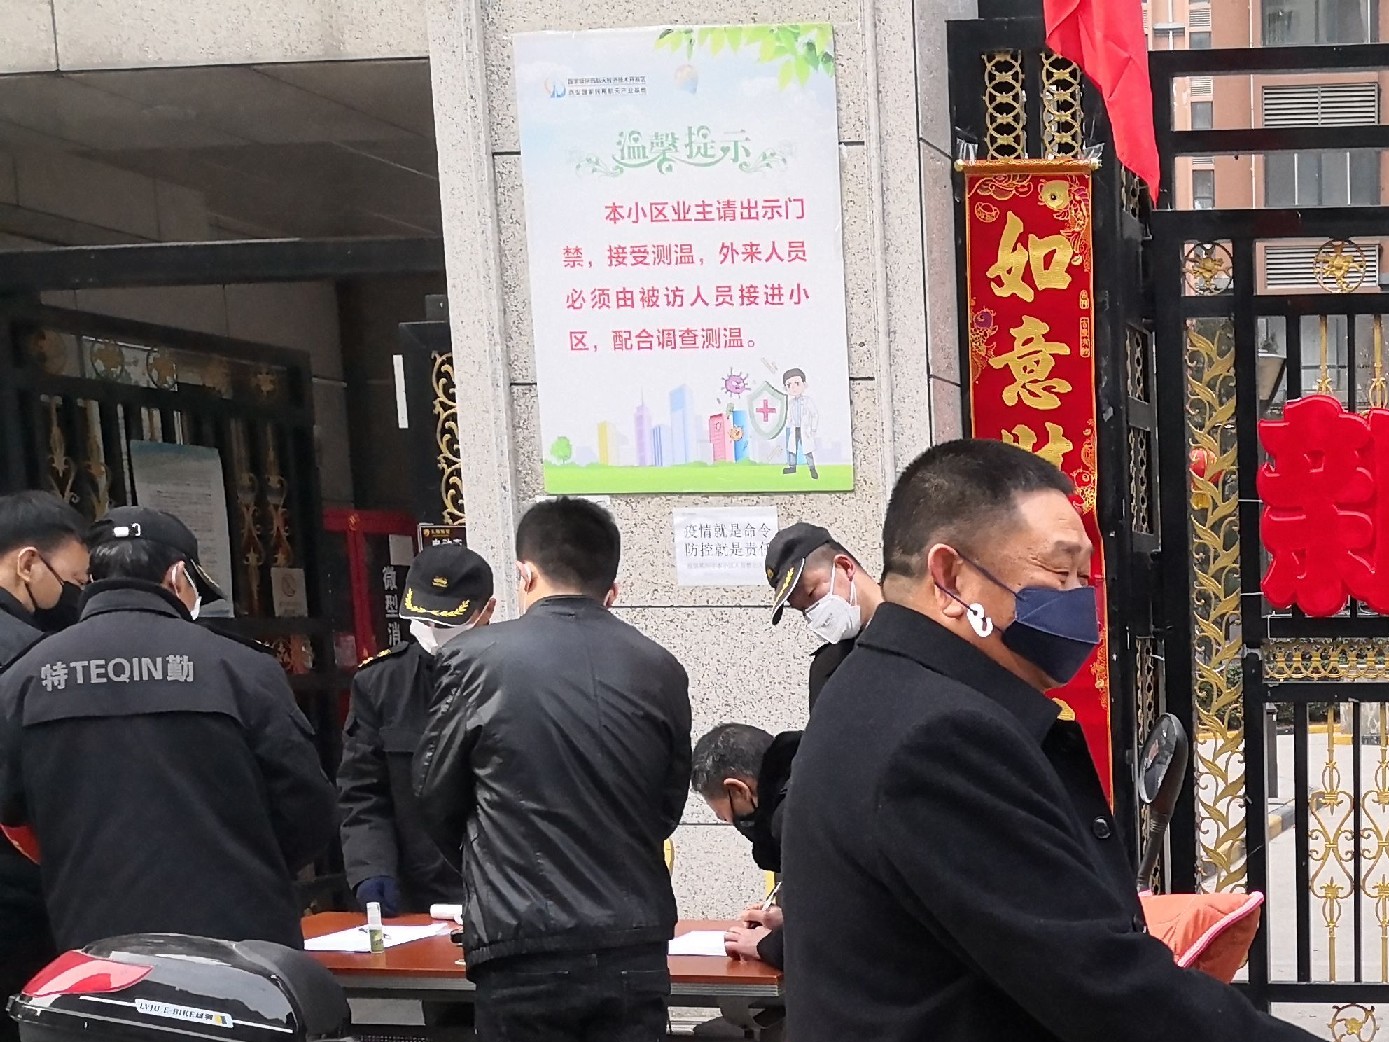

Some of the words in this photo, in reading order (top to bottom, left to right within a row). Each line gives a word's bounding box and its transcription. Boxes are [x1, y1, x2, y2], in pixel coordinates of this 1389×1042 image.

[613, 124, 752, 172] 温馨提示
[604, 197, 805, 224] 本小区业主请出示门
[565, 283, 810, 310] 必须由被访人员接进小
[684, 522, 772, 540] 疫情就是命令
